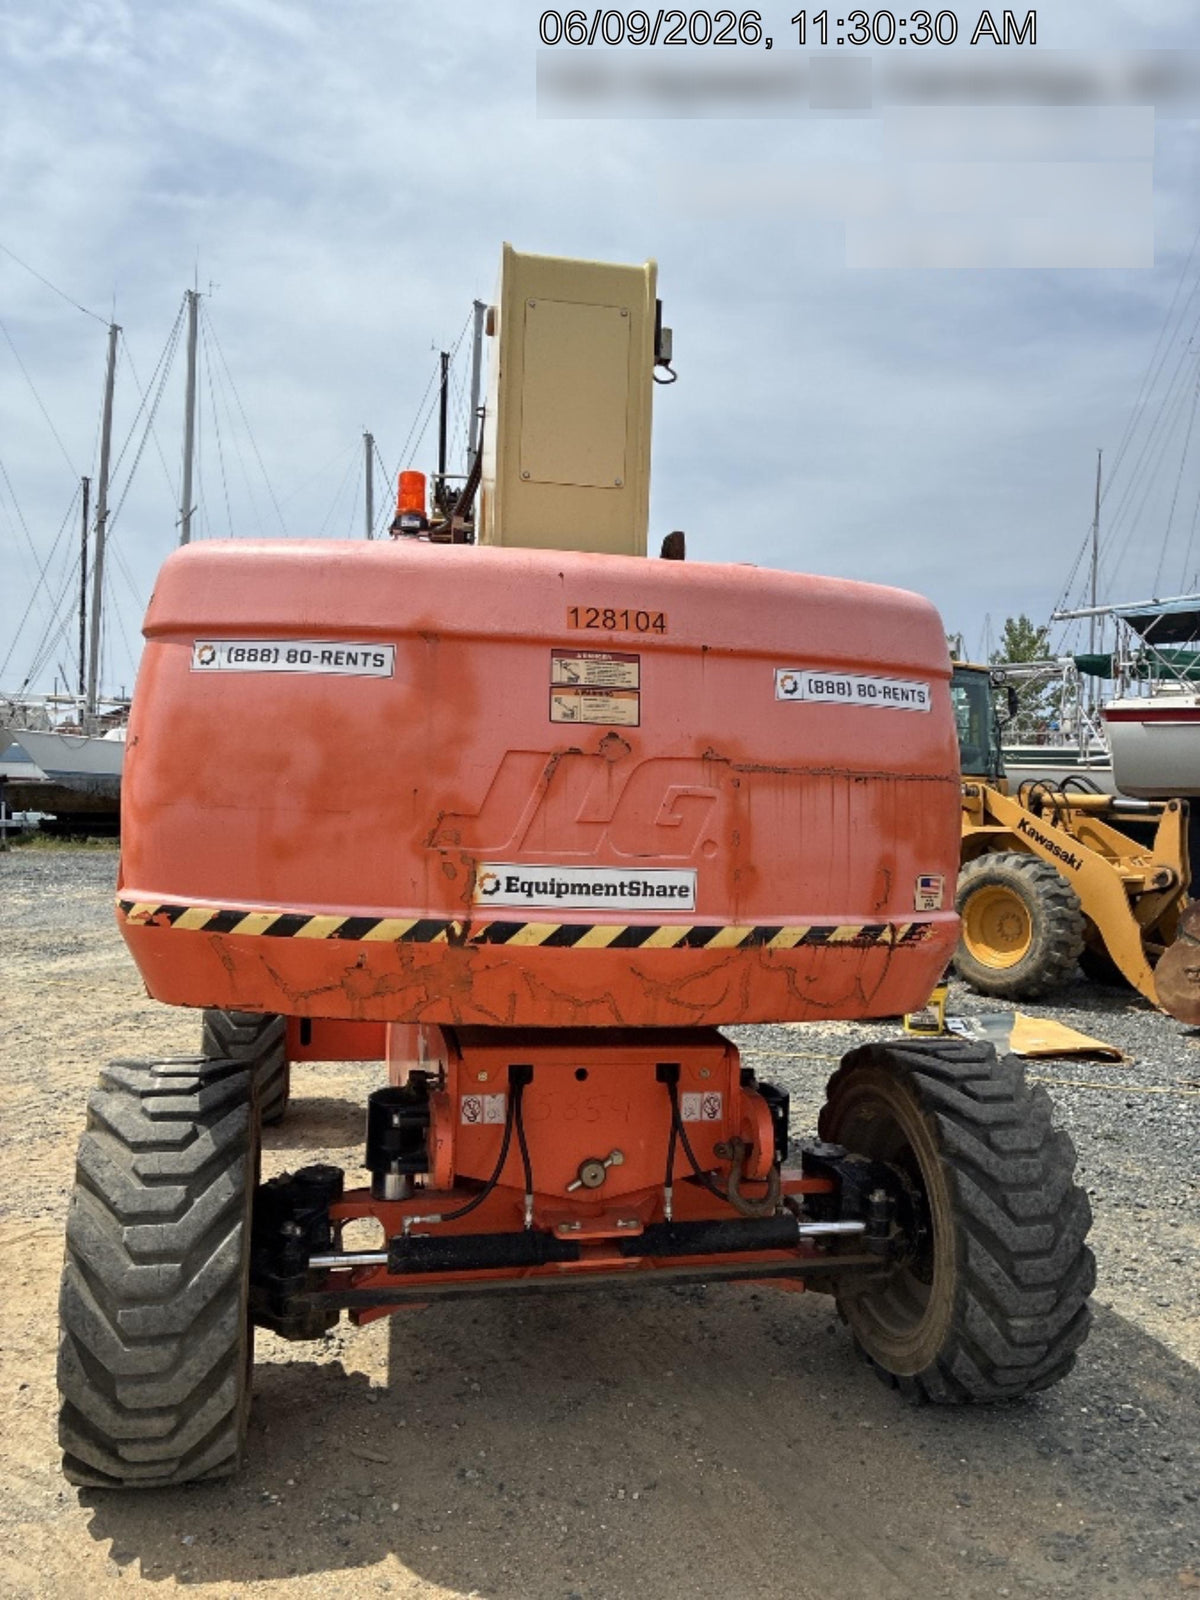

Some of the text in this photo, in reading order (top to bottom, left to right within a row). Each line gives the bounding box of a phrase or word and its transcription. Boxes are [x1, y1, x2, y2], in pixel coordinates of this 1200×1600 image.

[569, 607, 666, 633] 128104
[226, 646, 385, 668] (888) 80-RENTS
[808, 678, 926, 703] (888) 80-RENTS
[1017, 817, 1084, 871] Kawasaki
[504, 875, 690, 898] EquipmentShare
